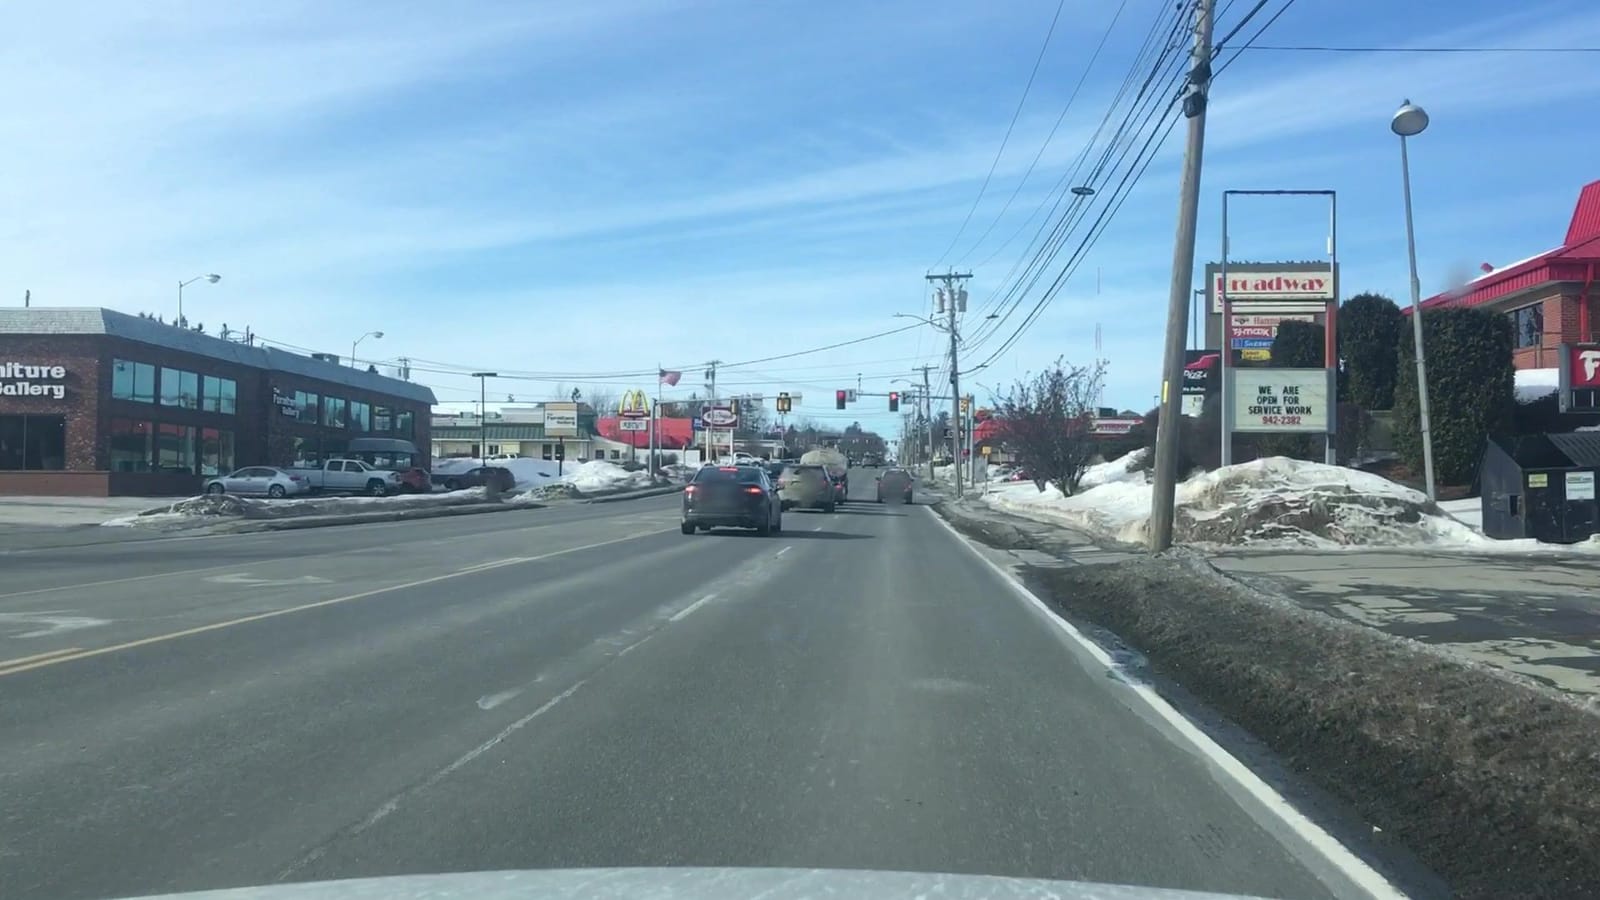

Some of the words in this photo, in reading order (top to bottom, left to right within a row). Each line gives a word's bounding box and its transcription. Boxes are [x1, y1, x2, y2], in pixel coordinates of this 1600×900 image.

[1258, 386, 1272, 395] WE
[1282, 386, 1299, 395] ARE
[1256, 396, 1278, 405] OPEN
[1283, 396, 1300, 405] FOR
[1248, 406, 1282, 415] SERVICE
[1285, 406, 1312, 415] WORK
[1262, 416, 1301, 425] 942-2382
